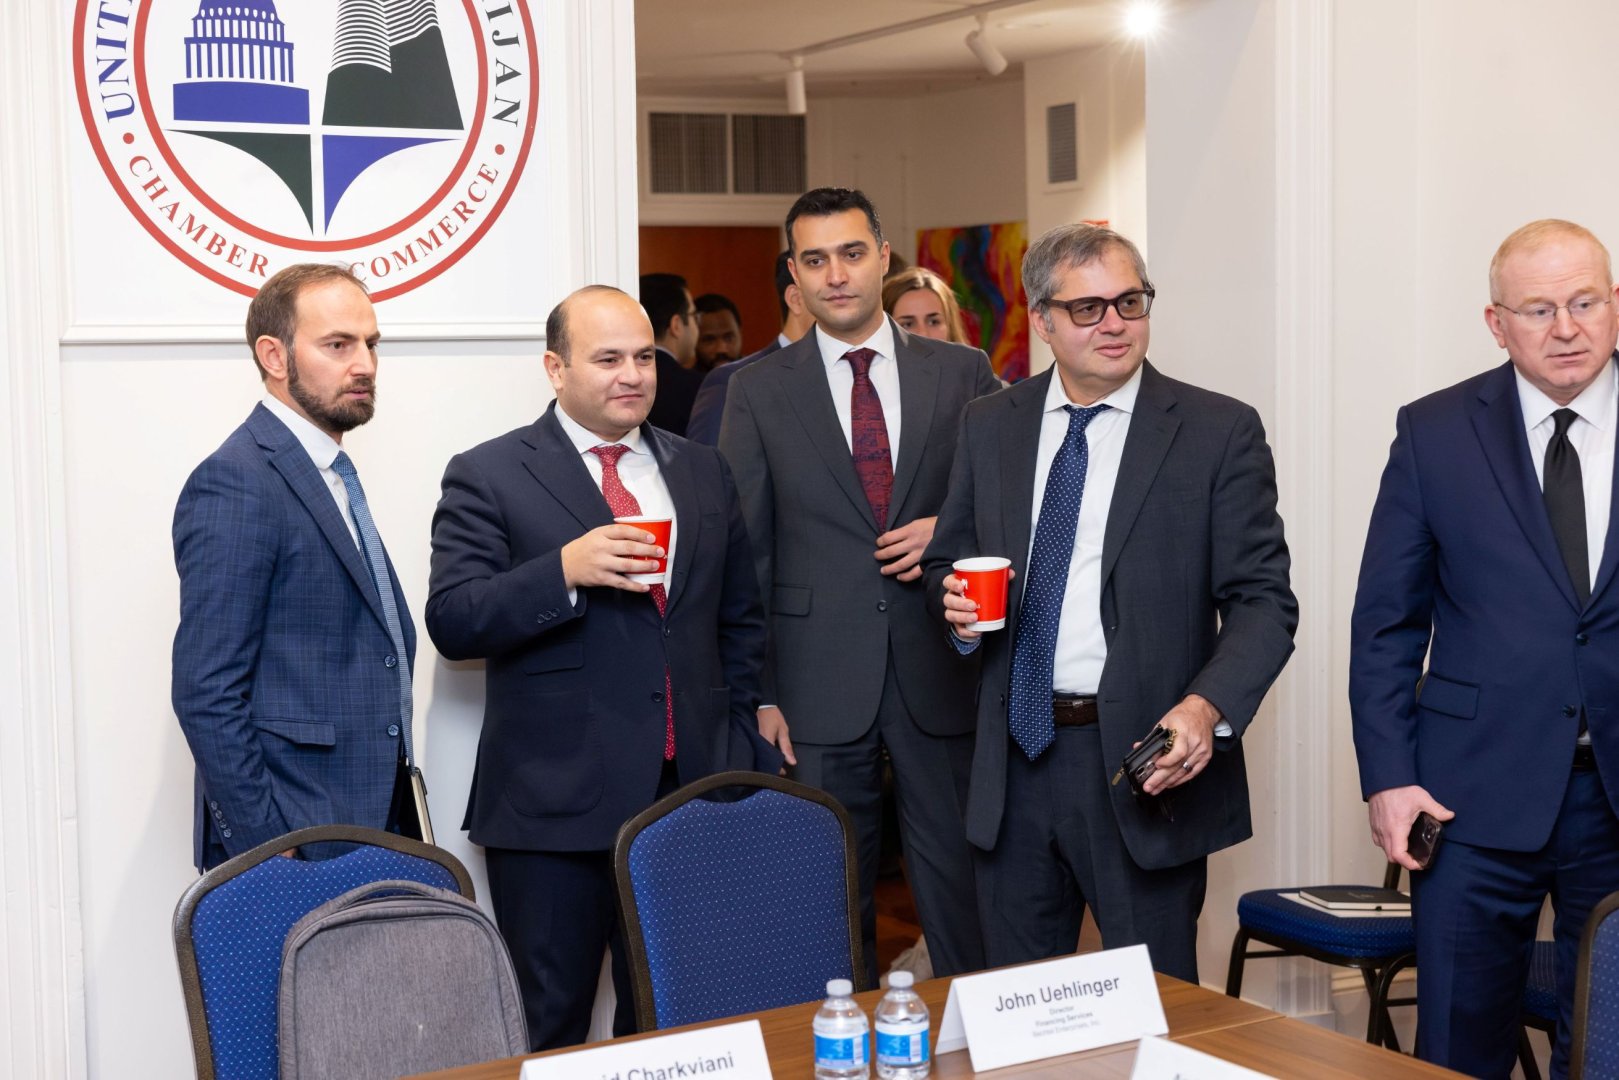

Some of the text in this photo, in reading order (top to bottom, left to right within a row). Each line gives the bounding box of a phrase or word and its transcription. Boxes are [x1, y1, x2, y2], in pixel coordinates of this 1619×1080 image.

[96, 0, 135, 122] UNIT
[482, 0, 522, 127] IJAN
[129, 155, 499, 281] CHAMBER COMMERCE
[995, 977, 1119, 1012] John Uehlinger
[1049, 1006, 1074, 1015] Director
[1066, 1012, 1093, 1022] Services
[628, 1051, 734, 1080] Charkviani
